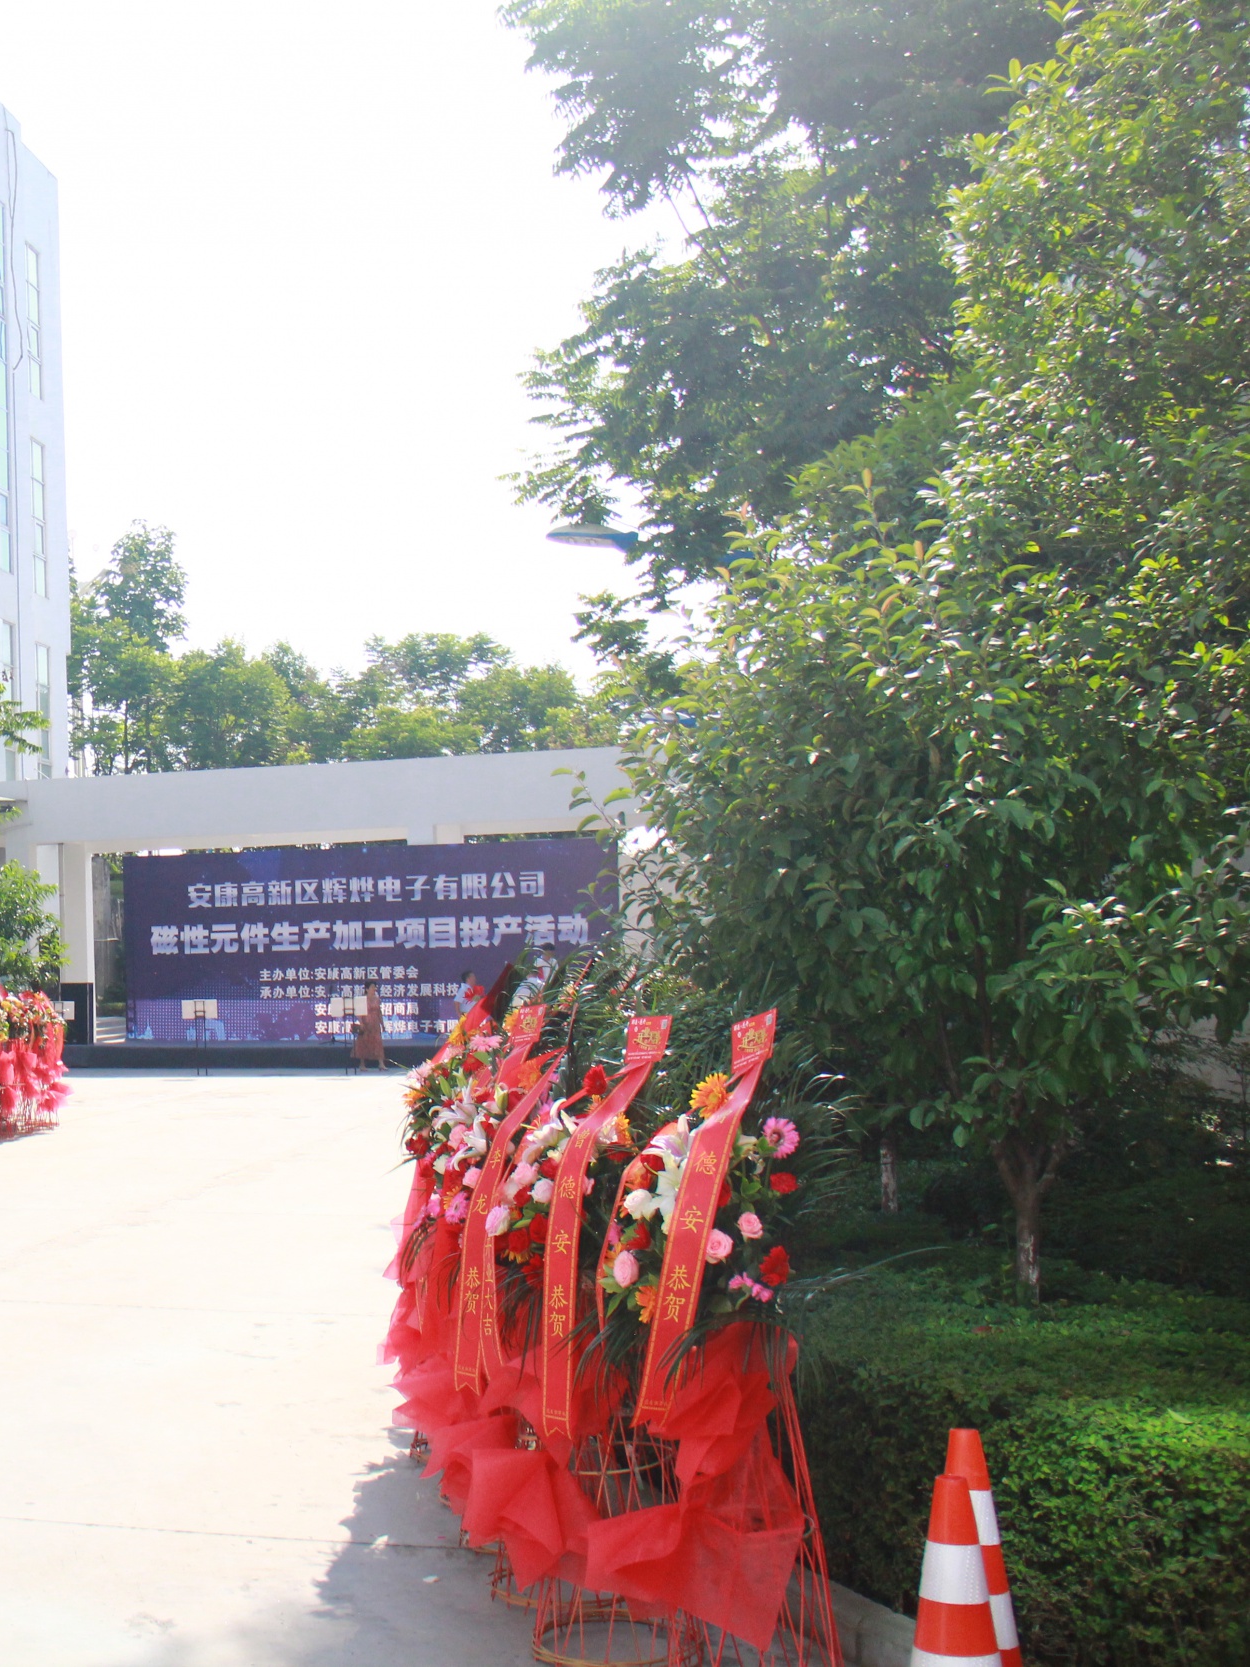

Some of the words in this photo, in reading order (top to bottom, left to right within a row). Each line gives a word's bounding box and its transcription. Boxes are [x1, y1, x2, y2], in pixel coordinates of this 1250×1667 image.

[188, 871, 546, 908] 安康高新区辉烨电子有限公司
[150, 914, 589, 955] 磁性元件生产加工项目投产活动
